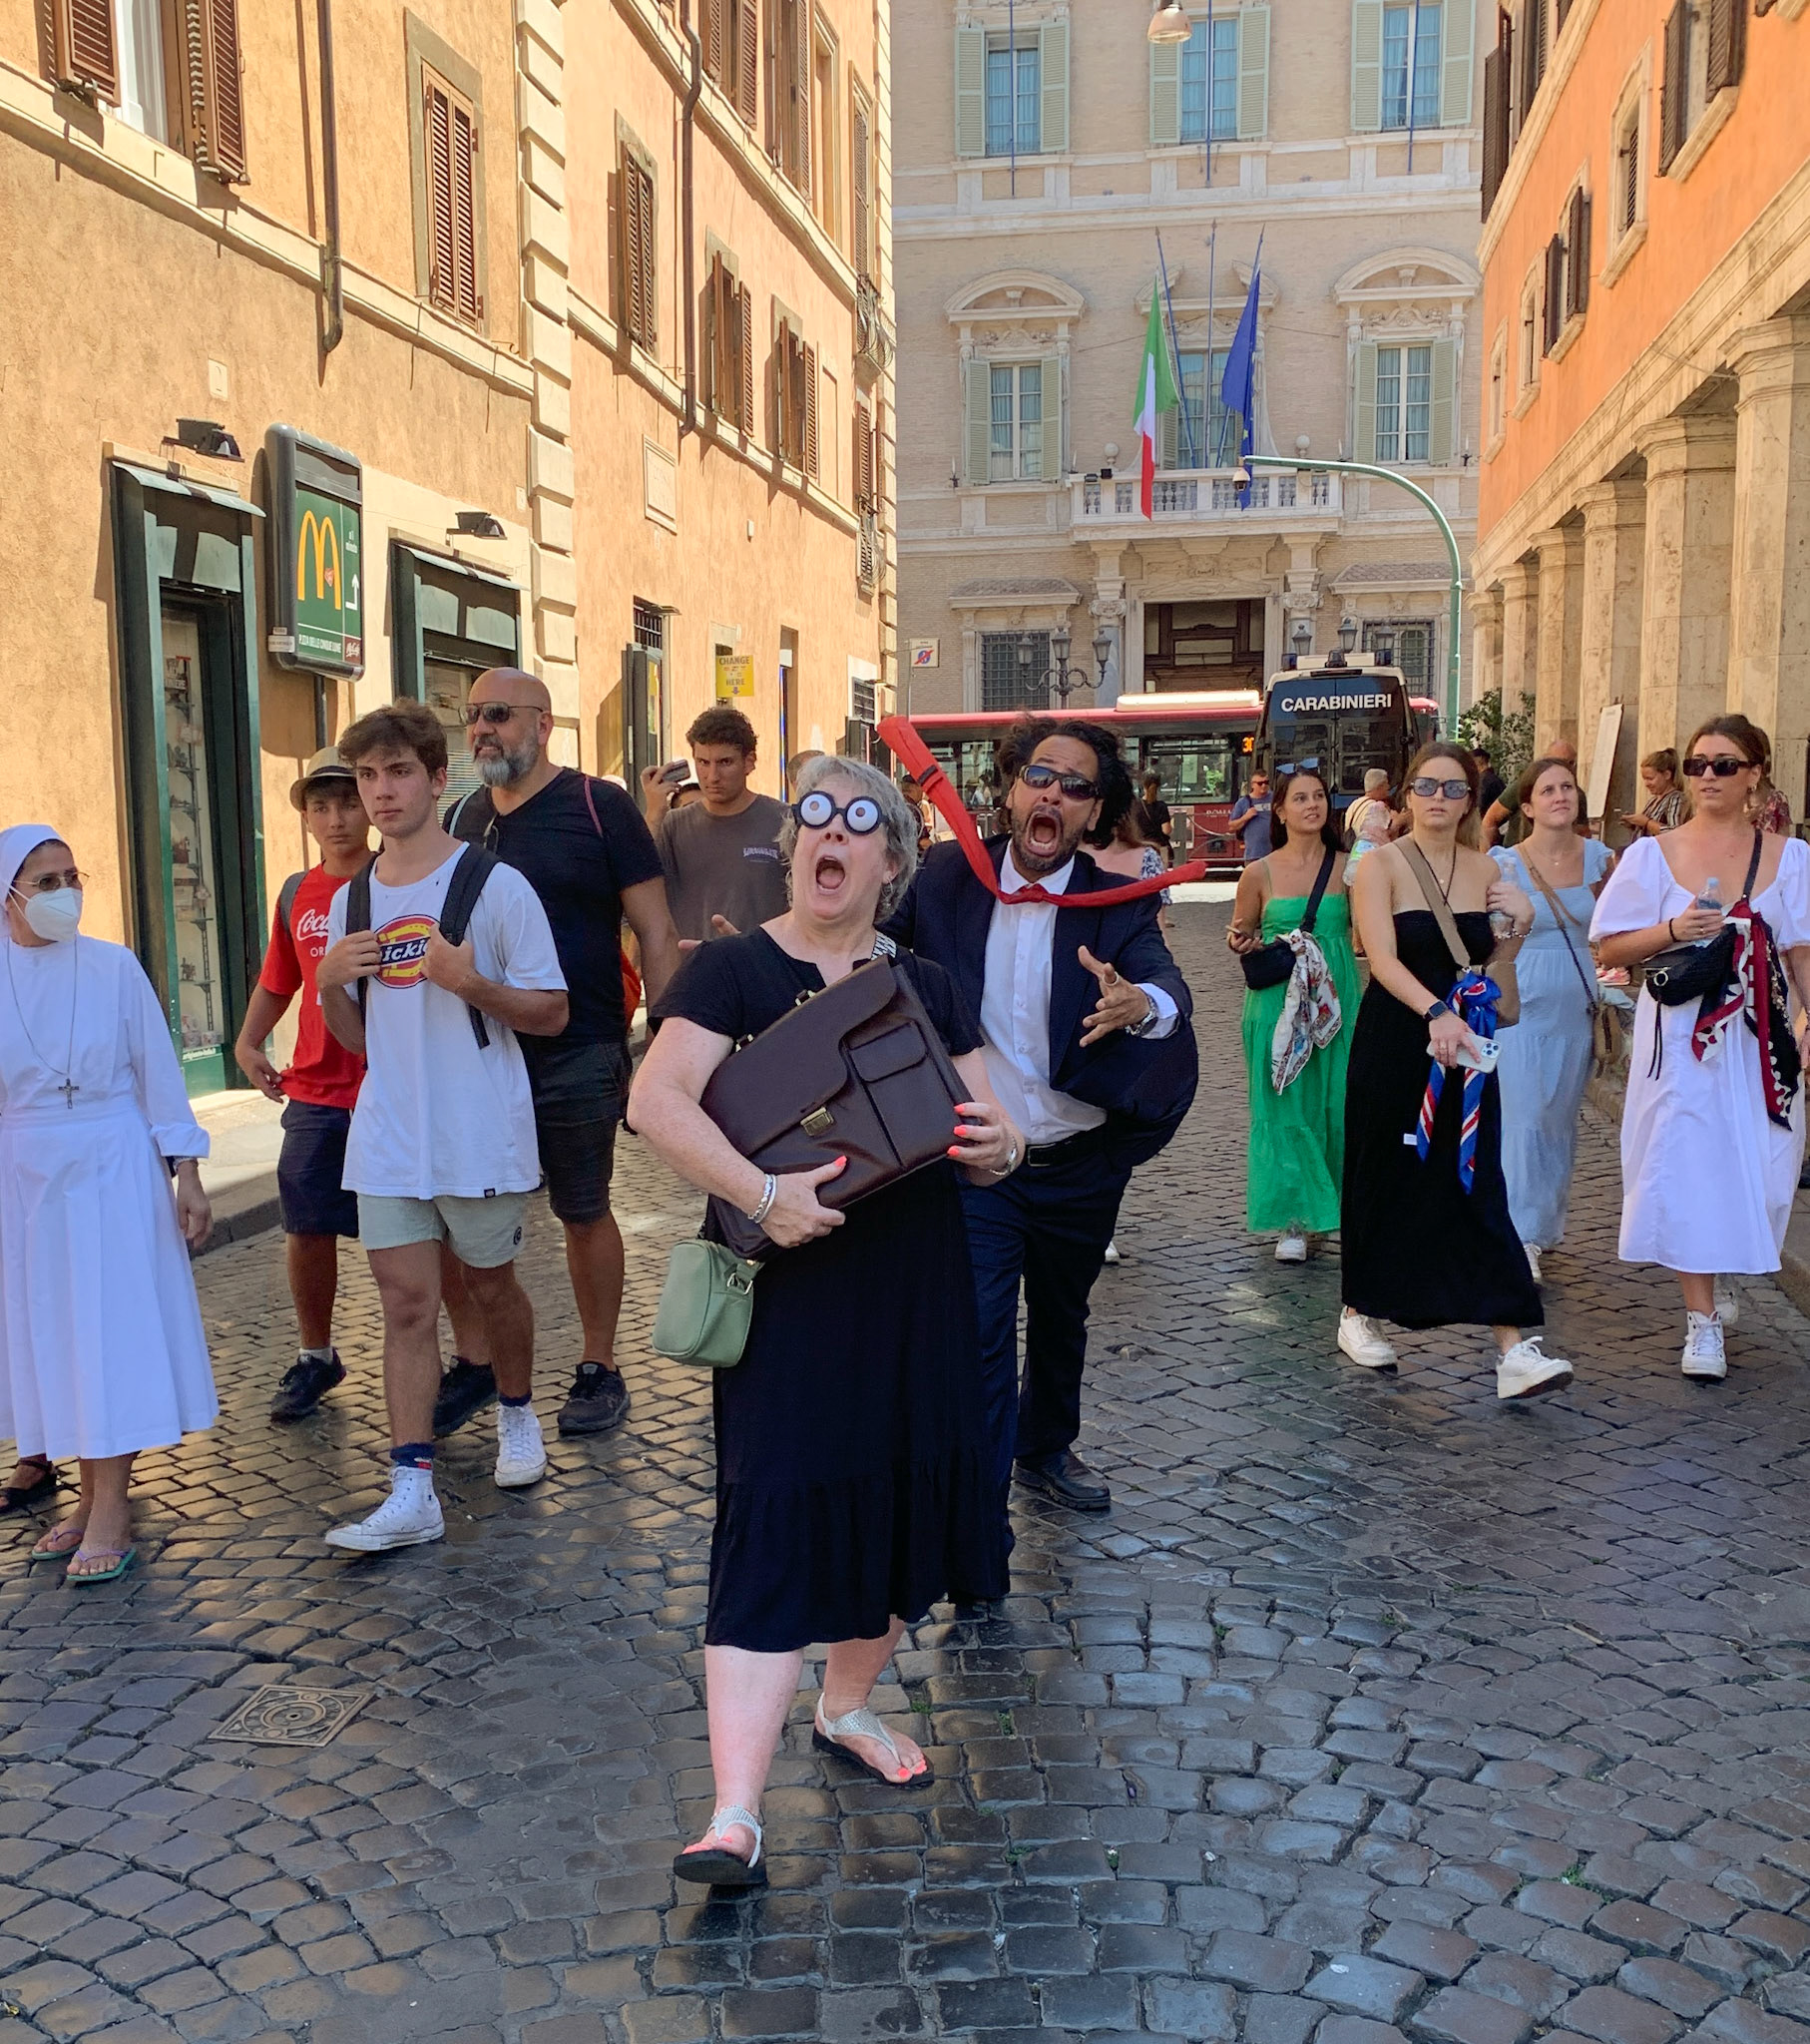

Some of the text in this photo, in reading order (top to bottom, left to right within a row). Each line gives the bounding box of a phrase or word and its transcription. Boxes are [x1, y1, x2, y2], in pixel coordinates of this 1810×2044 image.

[718, 656, 750, 666] CHANGE
[726, 678, 745, 687] HERE
[1281, 694, 1392, 713] CARABINIERI
